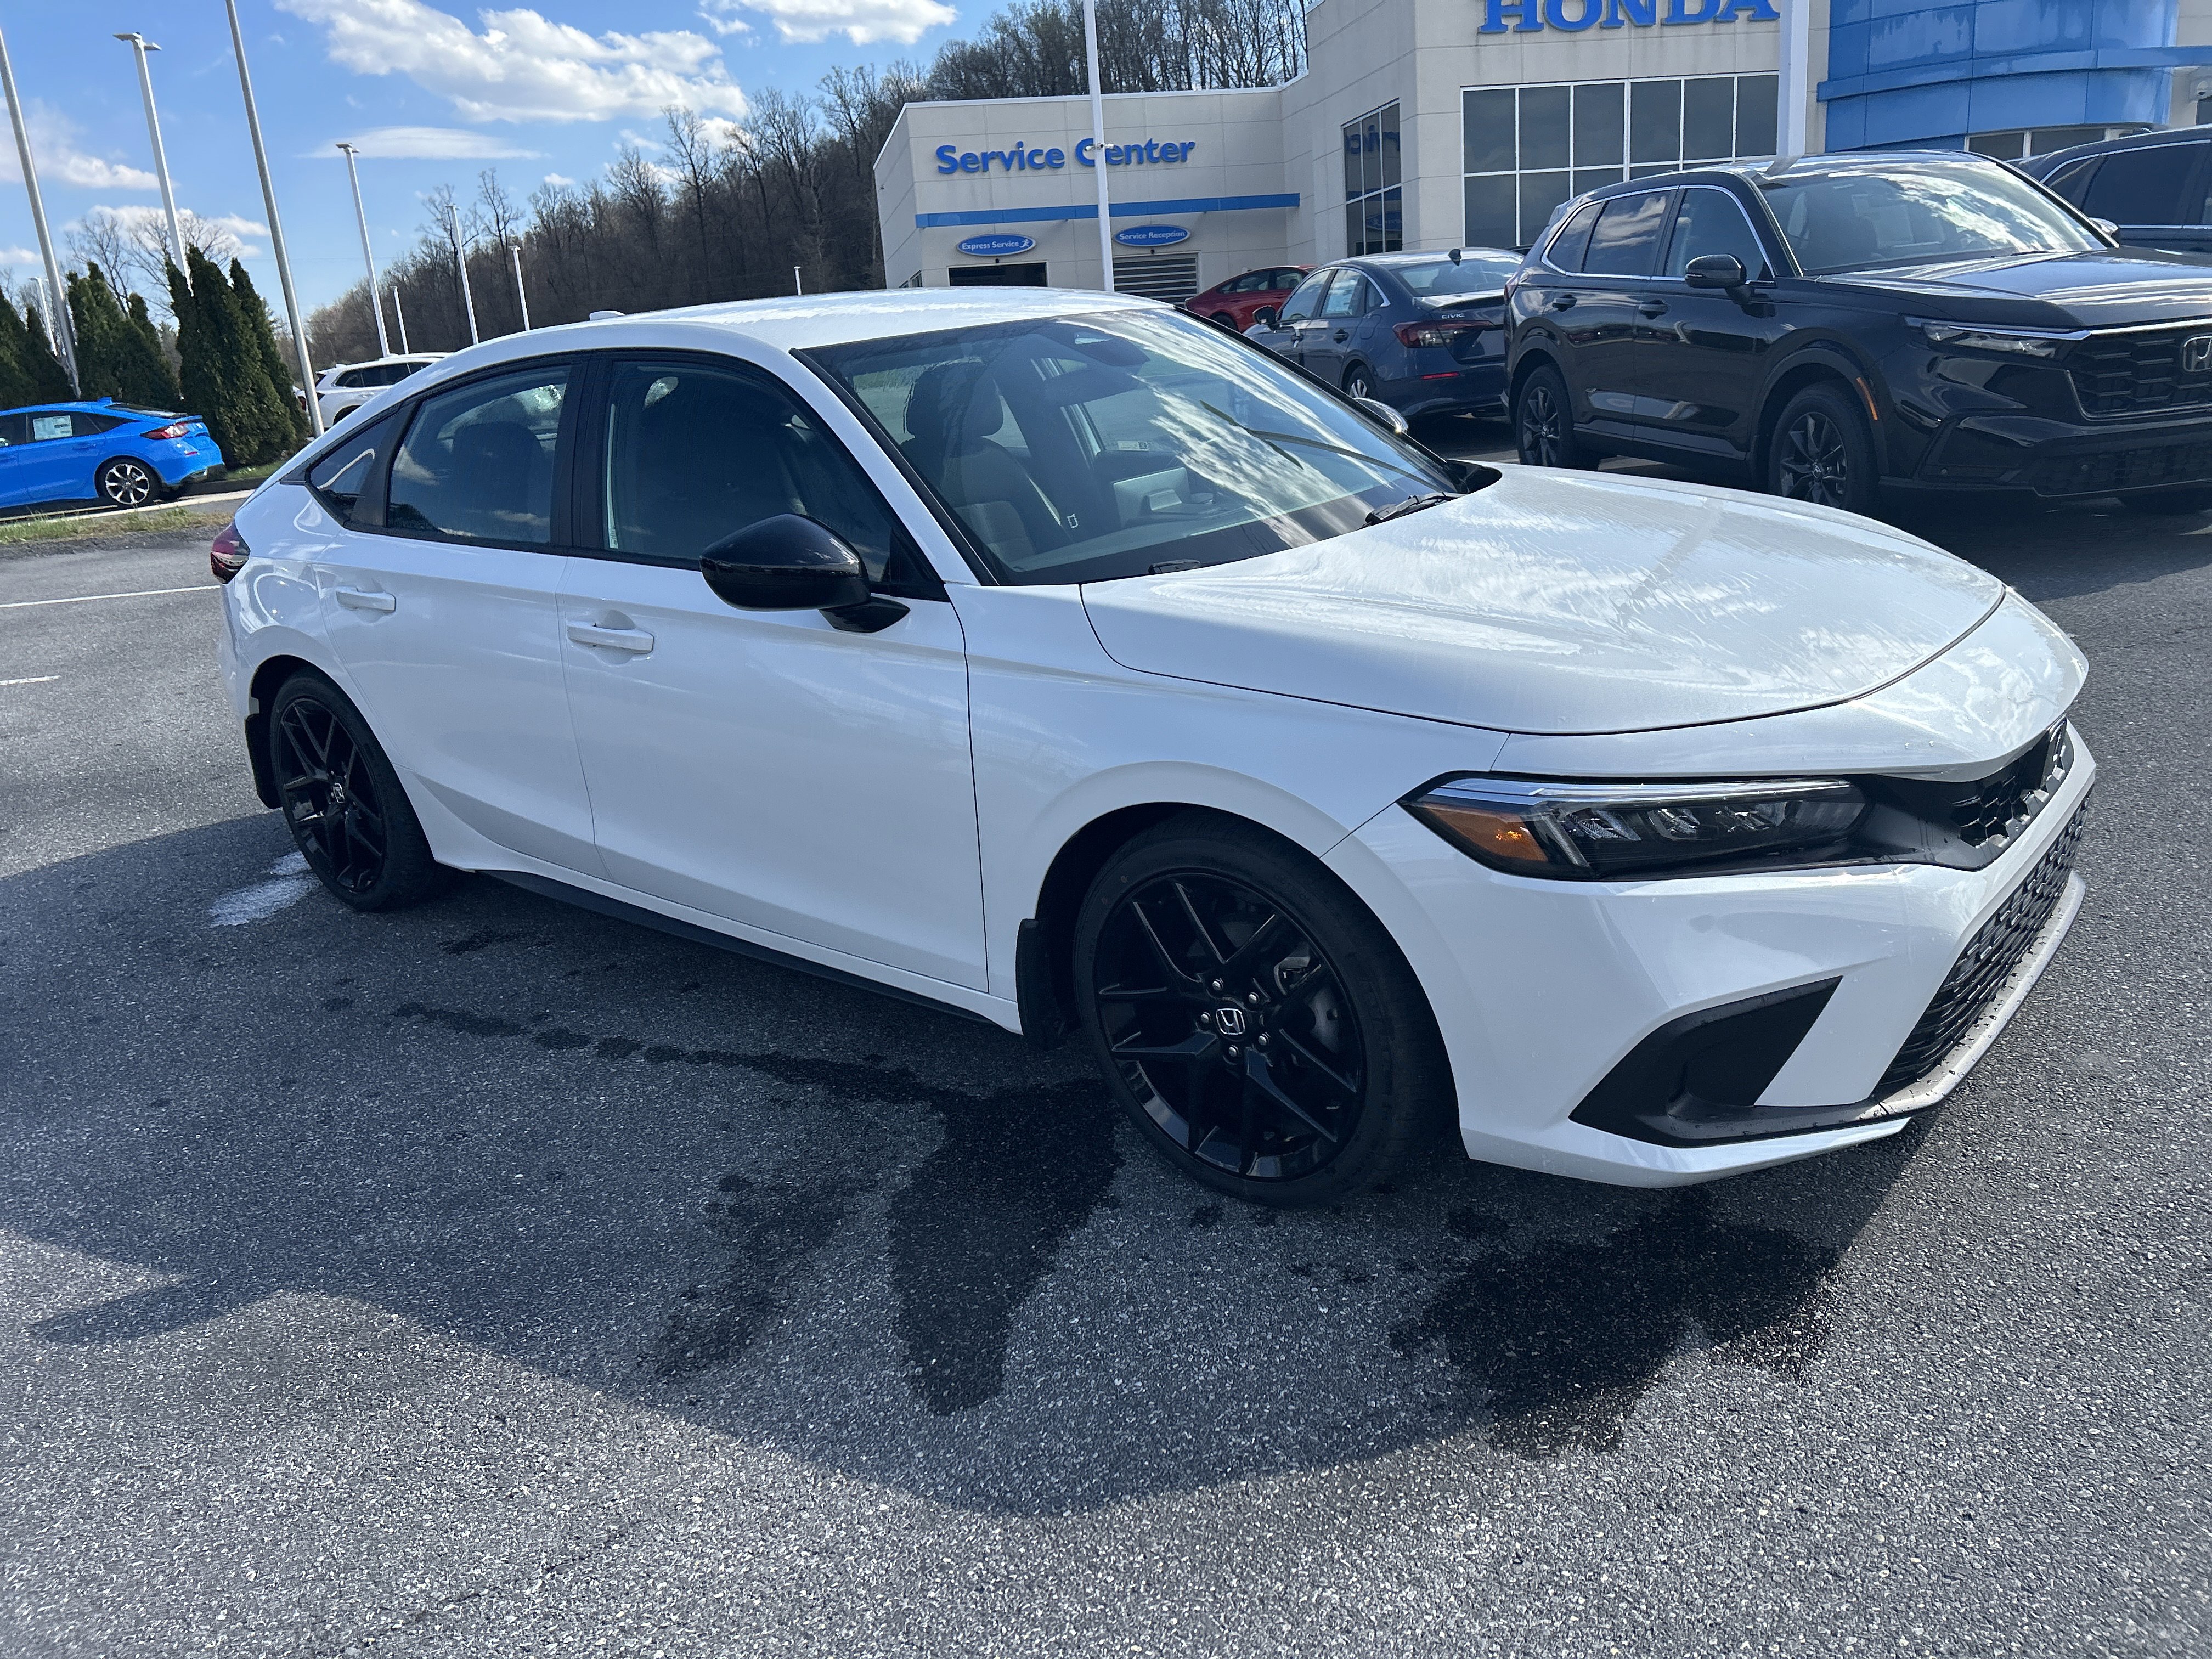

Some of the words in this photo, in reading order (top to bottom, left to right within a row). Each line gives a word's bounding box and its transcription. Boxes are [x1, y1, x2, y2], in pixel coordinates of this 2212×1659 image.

[936, 140, 1065, 174] Service
[1075, 138, 1195, 167] Center
[1119, 232, 1147, 240] Service
[1148, 230, 1185, 239] Reception
[962, 242, 990, 251] Express
